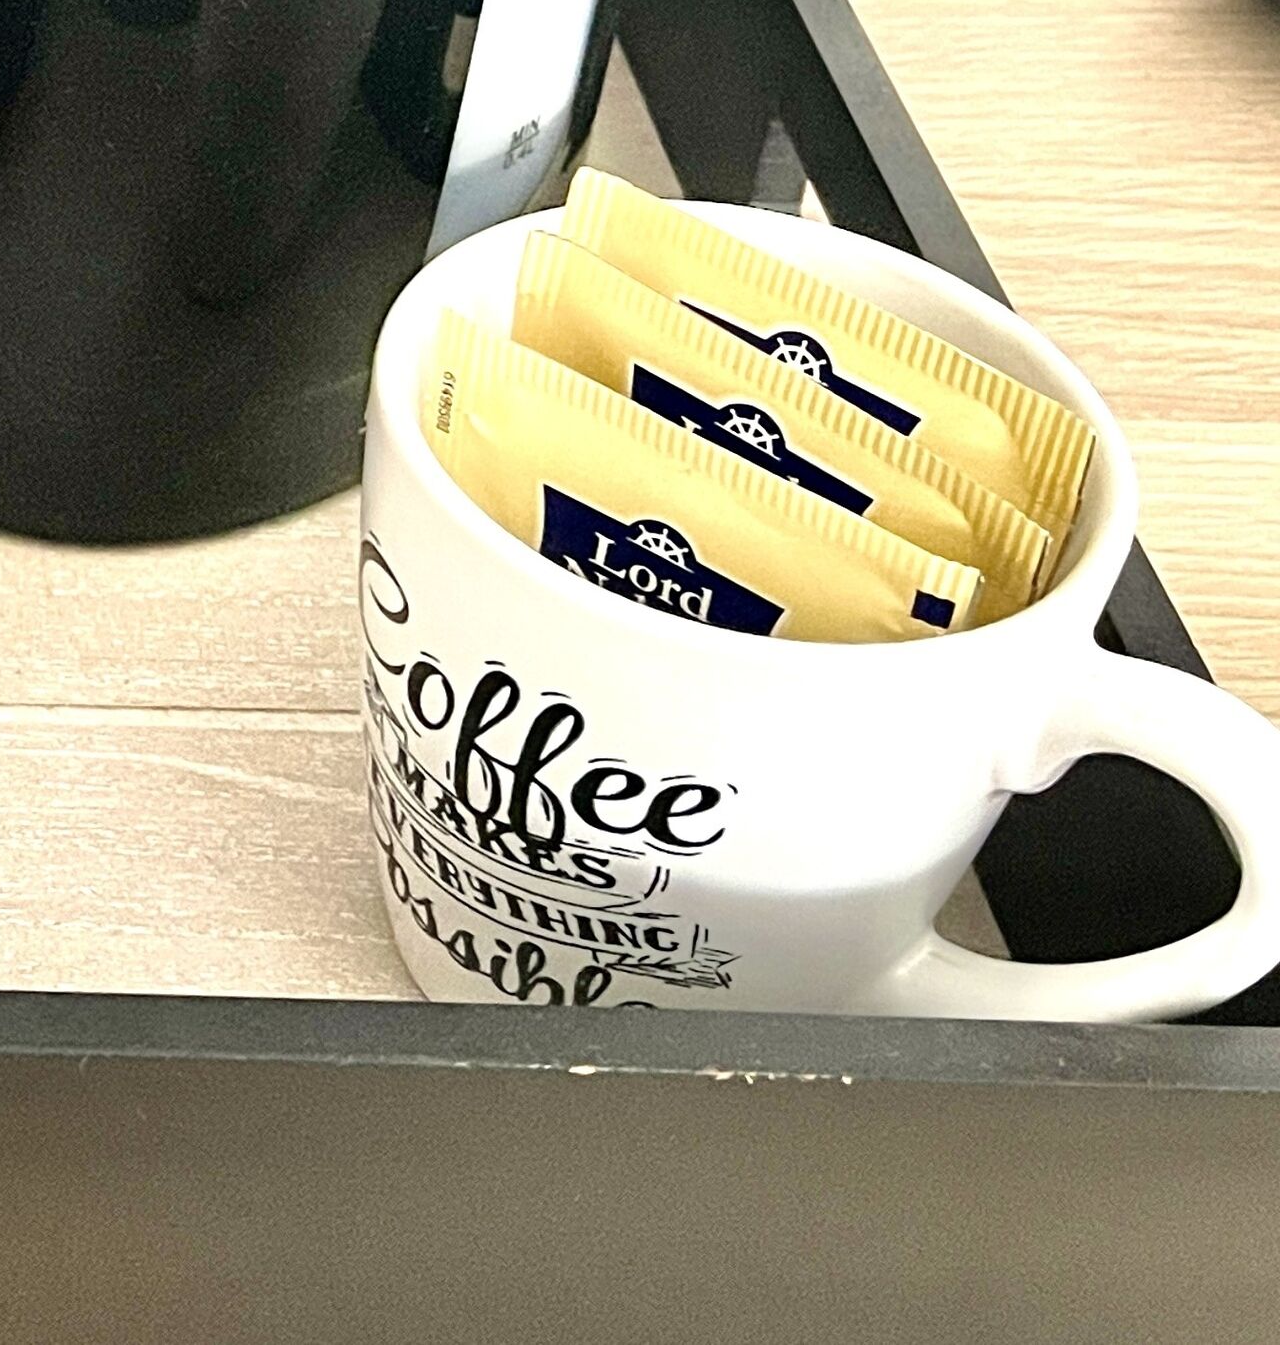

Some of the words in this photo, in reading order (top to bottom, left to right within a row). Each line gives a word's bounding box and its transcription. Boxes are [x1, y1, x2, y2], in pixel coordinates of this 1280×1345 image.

[588, 531, 713, 623] Lord
[360, 539, 726, 850] Coffee
[371, 794, 662, 1009] ossibl
[392, 744, 618, 890] MAKES
